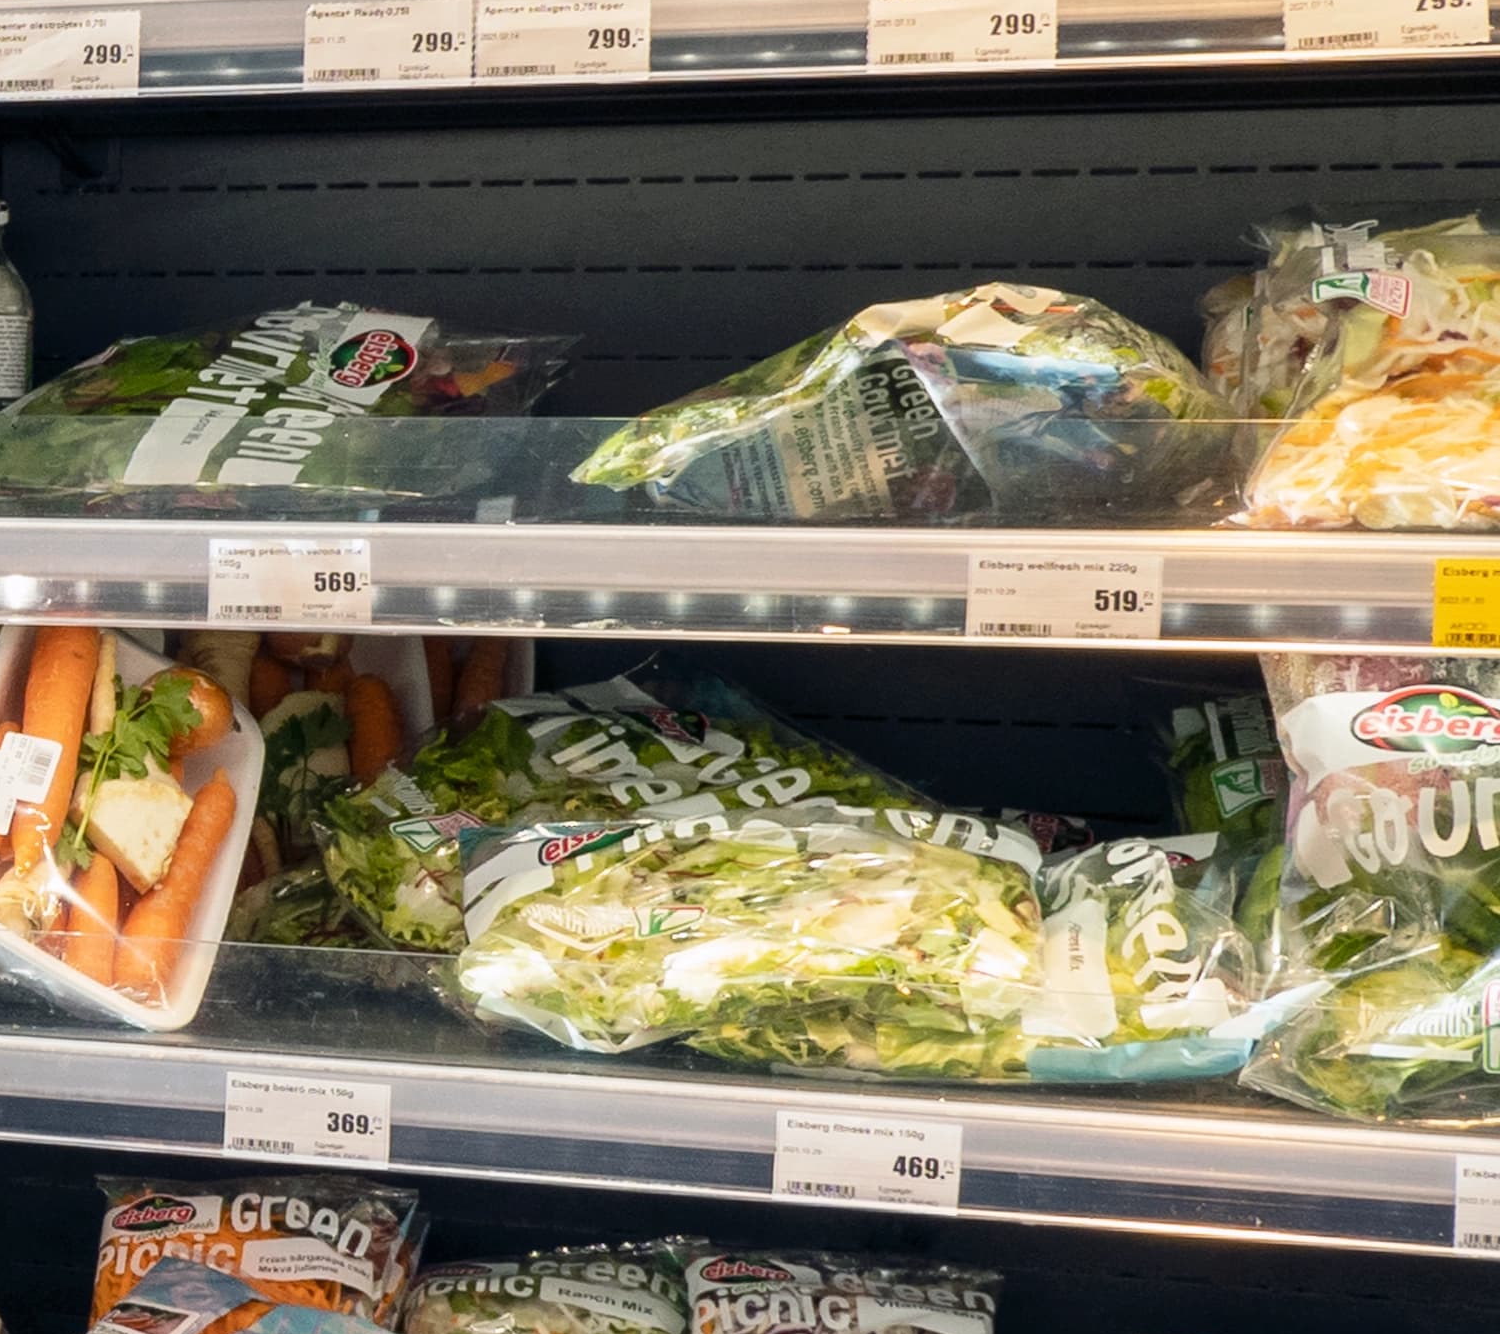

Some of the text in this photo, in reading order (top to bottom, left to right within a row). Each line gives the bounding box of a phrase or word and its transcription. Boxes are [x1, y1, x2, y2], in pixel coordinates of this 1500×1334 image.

[113, 1206, 195, 1229] eisberg
[230, 1192, 372, 1258] Green
[558, 1287, 654, 1318] Ranch Mix
